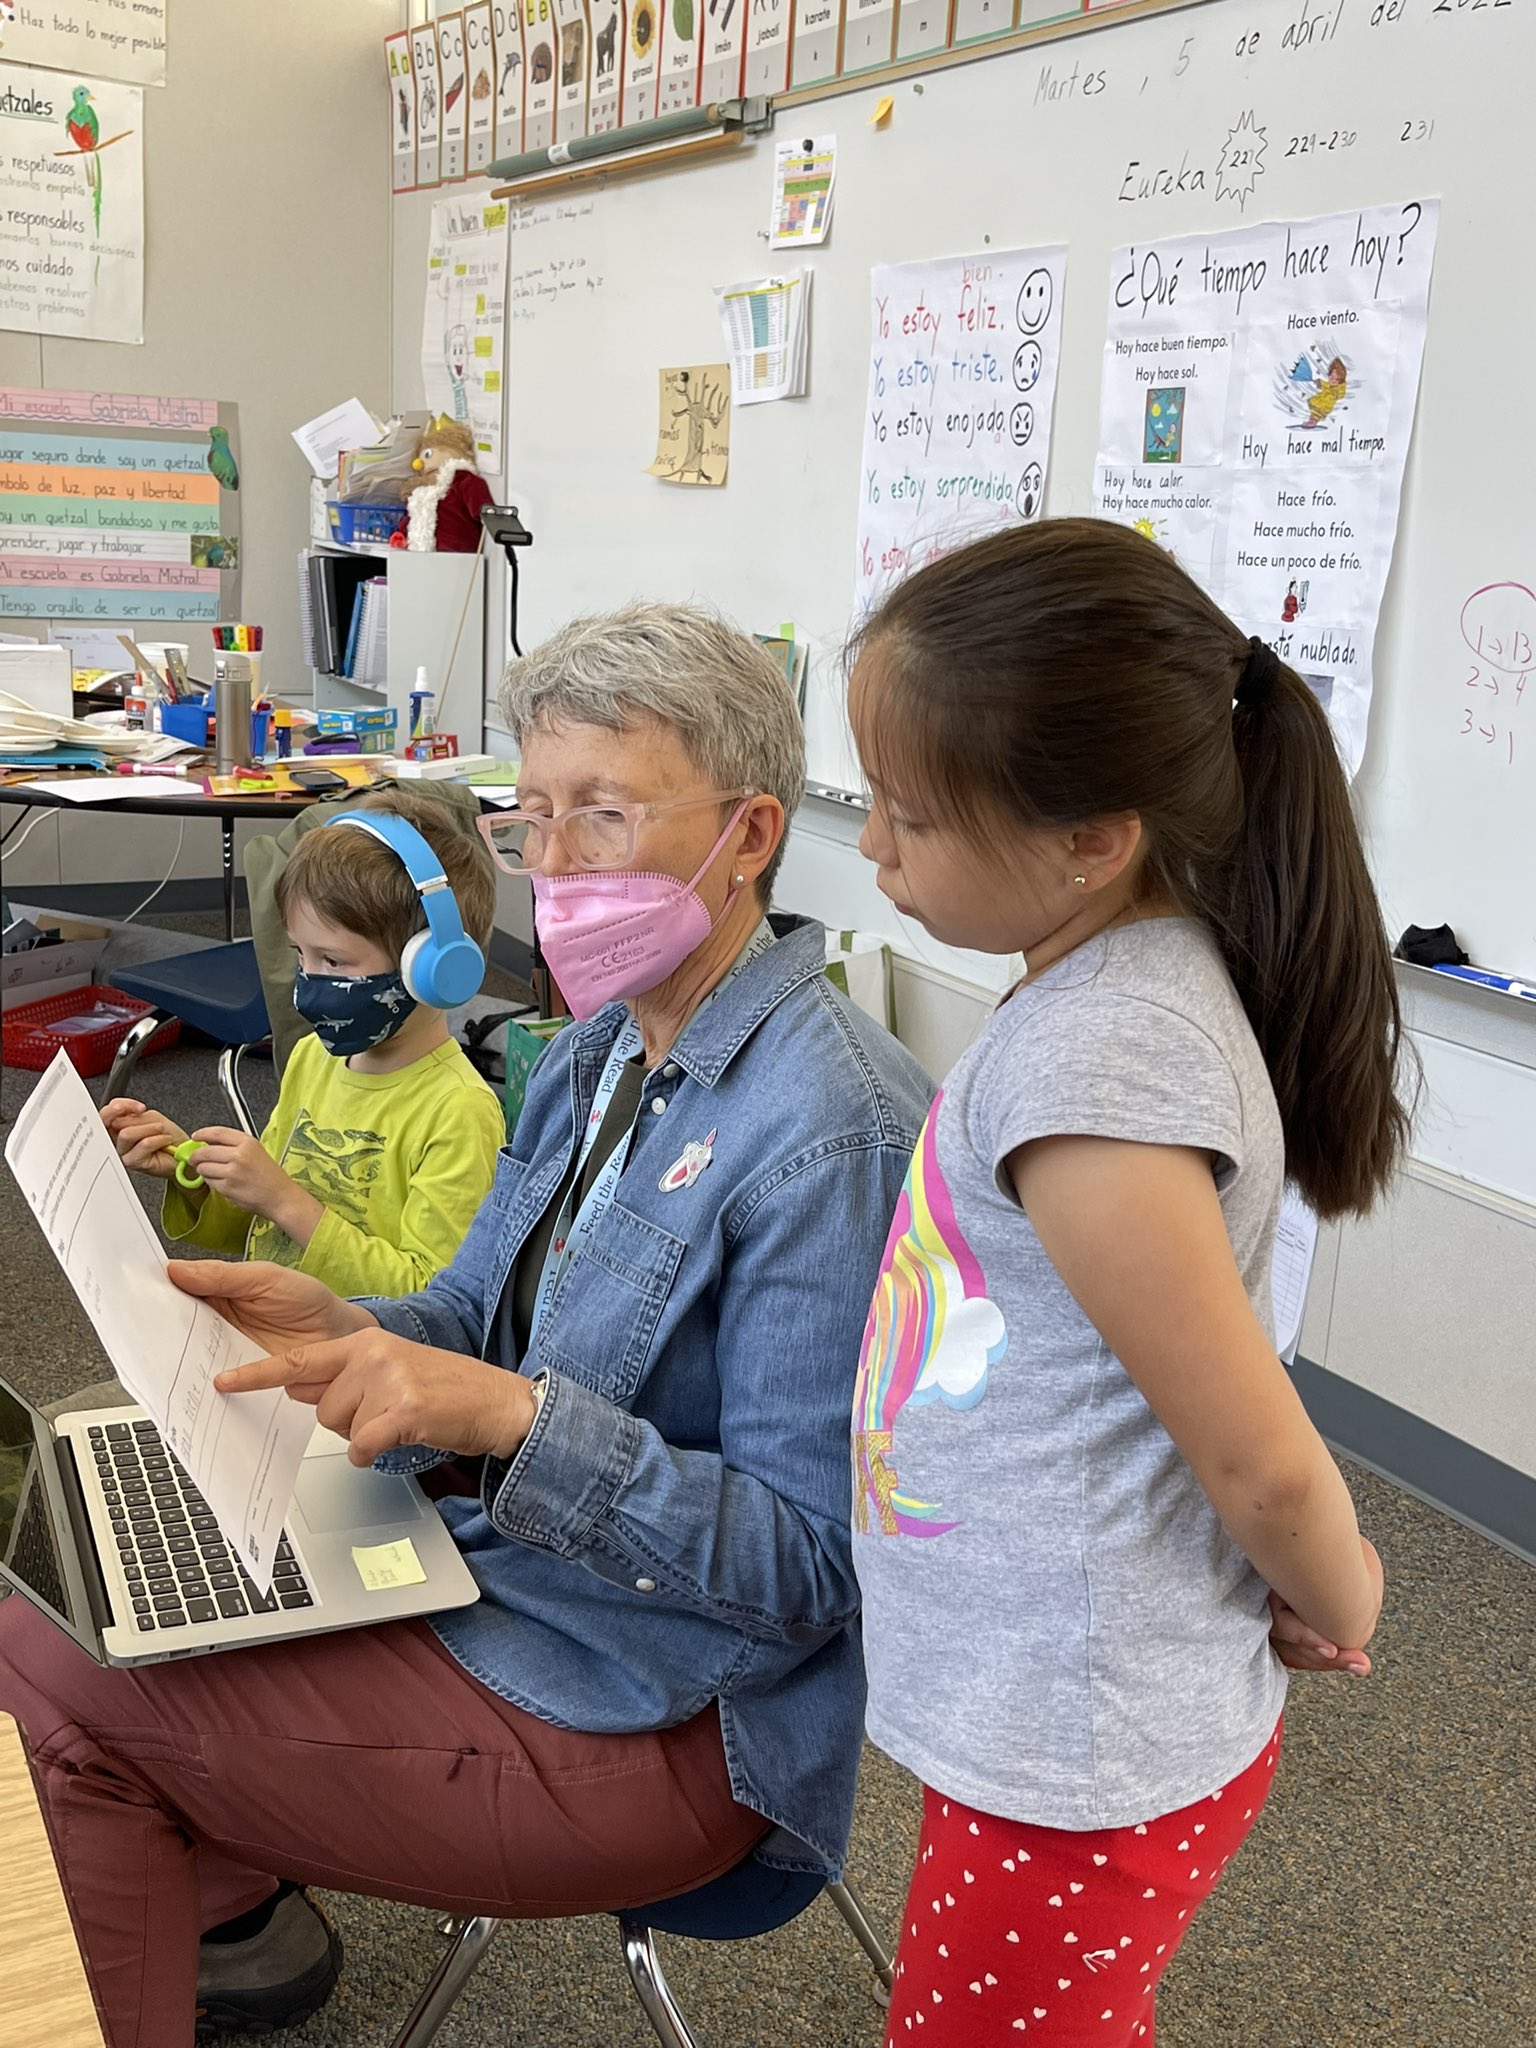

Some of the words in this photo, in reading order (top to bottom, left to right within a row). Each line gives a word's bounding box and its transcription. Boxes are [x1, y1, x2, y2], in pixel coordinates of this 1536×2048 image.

[805, 9, 830, 25] karate
[20, 8, 45, 29] Haz
[53, 14, 79, 34] todo
[86, 20, 96, 40] lo
[100, 31, 128, 49] mejor
[132, 37, 167, 54] posible
[756, 22, 780, 45] jabalí
[673, 54, 688, 67] hoja
[1034, 60, 1106, 106] Martes
[1175, 37, 1194, 76] 5
[1235, 27, 1260, 56] de
[1281, 0, 1344, 50] abril
[0, 86, 53, 116] etzales
[12, 154, 75, 181] respetuosos
[1118, 150, 1205, 200] Eureka
[1229, 150, 1254, 168] 227
[1400, 119, 1435, 142] 231
[7, 209, 85, 236] responsables
[26, 256, 74, 276] cuidado
[1114, 246, 1184, 320] ¿Qué
[1200, 245, 1267, 316] tiempo
[1283, 226, 1330, 279] hace
[1350, 201, 1422, 300] hoy?
[45, 283, 87, 299] resolver
[37, 302, 86, 321] problemas
[876, 296, 890, 339] Yo
[902, 288, 942, 357] estoy
[957, 284, 1005, 333] feliz.
[1287, 313, 1317, 330] Hace
[1319, 308, 1360, 326] viento.
[1115, 340, 1133, 358] Hoy
[1135, 337, 1159, 353] hace
[1161, 336, 1184, 352] buen
[1186, 334, 1229, 353] tiempo.
[874, 357, 886, 398] Yo
[897, 351, 938, 408] estoy
[952, 344, 1004, 383] triste.
[1135, 367, 1155, 384] Hoy
[1157, 365, 1180, 381] hace
[1181, 363, 1199, 379] sol.
[25, 398, 72, 415] escuela
[90, 394, 150, 421] Gabriela
[157, 397, 204, 424] Mistral
[872, 409, 887, 442] Yo
[896, 402, 934, 458] estoy
[946, 399, 1006, 449] enojado.
[32, 450, 69, 466] seguro
[75, 447, 107, 465] donde
[118, 455, 137, 470] soy
[141, 456, 156, 468] un
[1243, 434, 1268, 468] Hoy
[1287, 432, 1313, 456] hace
[1321, 425, 1343, 453] mal
[1349, 429, 1386, 461] tiempo.
[37, 476, 52, 493] de
[94, 484, 116, 499] paz
[126, 489, 135, 499] y
[866, 468, 880, 505] Yo
[891, 466, 926, 517] estoy
[936, 470, 1014, 513] sorprendido.
[1104, 469, 1125, 495] Hoy
[1132, 469, 1152, 489] hace
[1102, 495, 1123, 513] Hoy
[1125, 495, 1149, 508] hace
[1151, 495, 1183, 509] mucho
[1184, 495, 1212, 509] calor.
[1277, 491, 1306, 506] Hace
[1311, 490, 1337, 506] frío.
[21, 512, 37, 523] un
[45, 508, 88, 526] quetzal
[98, 509, 153, 528] bondadoso
[159, 519, 168, 530] y
[171, 519, 187, 529] me
[192, 517, 219, 533] gusta
[1253, 522, 1284, 537] Hace
[1286, 522, 1326, 538] mucho
[1329, 521, 1355, 538] frío.
[57, 538, 85, 555] jugar
[91, 541, 98, 554] y
[861, 536, 874, 577] Yo
[1237, 551, 1268, 567] Hace
[1270, 557, 1286, 568] un
[1287, 556, 1316, 571] poco
[1319, 553, 1336, 568] de
[1339, 553, 1362, 570] frío.
[20, 563, 68, 581] escuela
[80, 571, 94, 582] es
[101, 565, 151, 584] Gabriela
[158, 568, 200, 585] Mistral
[0, 594, 37, 615] Tengo
[46, 597, 85, 616] orgullo
[94, 599, 108, 614] de
[122, 604, 141, 615] ser
[150, 604, 165, 616] un
[1300, 631, 1358, 665] nublado.
[1466, 666, 1480, 687] 2
[1460, 708, 1473, 734] 3
[755, 933, 773, 951] the
[618, 1032, 638, 1055] the
[601, 1057, 626, 1093] Read
[598, 1175, 614, 1199] the
